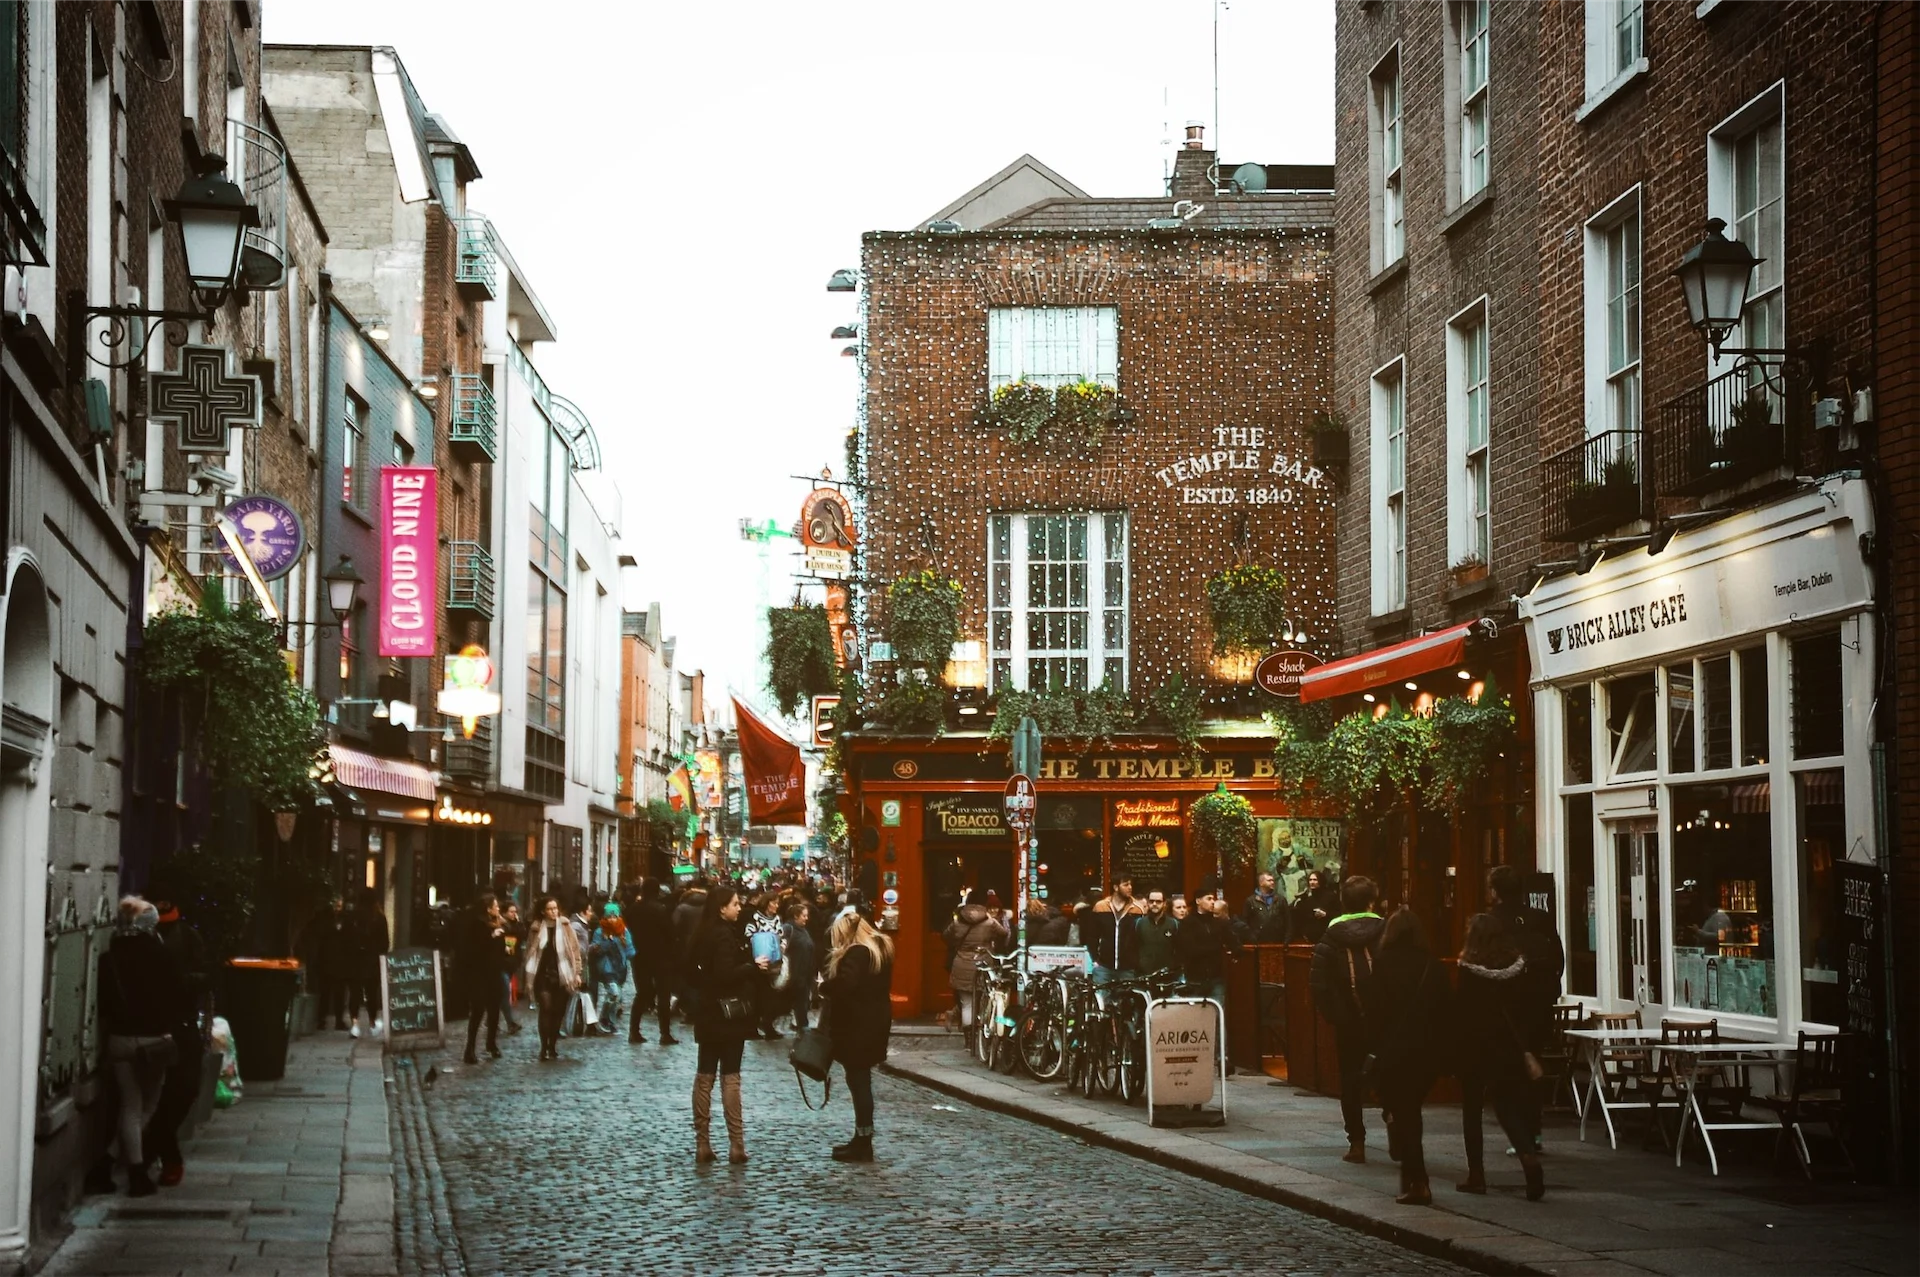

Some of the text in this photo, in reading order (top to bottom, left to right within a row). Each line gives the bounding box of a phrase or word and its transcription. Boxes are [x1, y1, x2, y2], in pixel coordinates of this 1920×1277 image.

[1213, 427, 1265, 447] THE
[1156, 450, 1324, 489] TEMPLE BAR
[1247, 488, 1293, 504] 1840
[392, 474, 425, 537] NINE
[227, 501, 295, 536] EAL'S YARD
[816, 549, 841, 558] DUBLIN
[811, 560, 845, 571] LIVE MUSIC
[391, 544, 424, 630] CLOUD
[1774, 571, 1832, 597] Temple Bar, Dublin
[1566, 616, 1605, 650] BRICK
[1608, 604, 1646, 640] ALLEY
[1266, 674, 1299, 685] Restau
[897, 763, 912, 773] 48
[1037, 759, 1079, 778] HE
[1093, 759, 1235, 778] TEMPLE
[751, 778, 799, 795] TEMPLE
[765, 775, 784, 783] THE
[766, 791, 788, 803] BAR
[1116, 801, 1177, 814] Traditional
[1115, 815, 1180, 827] Irish Music
[1309, 838, 1339, 850] BAR
[1844, 878, 1871, 900] BRICK
[1156, 1030, 1209, 1045] ARIOSA
